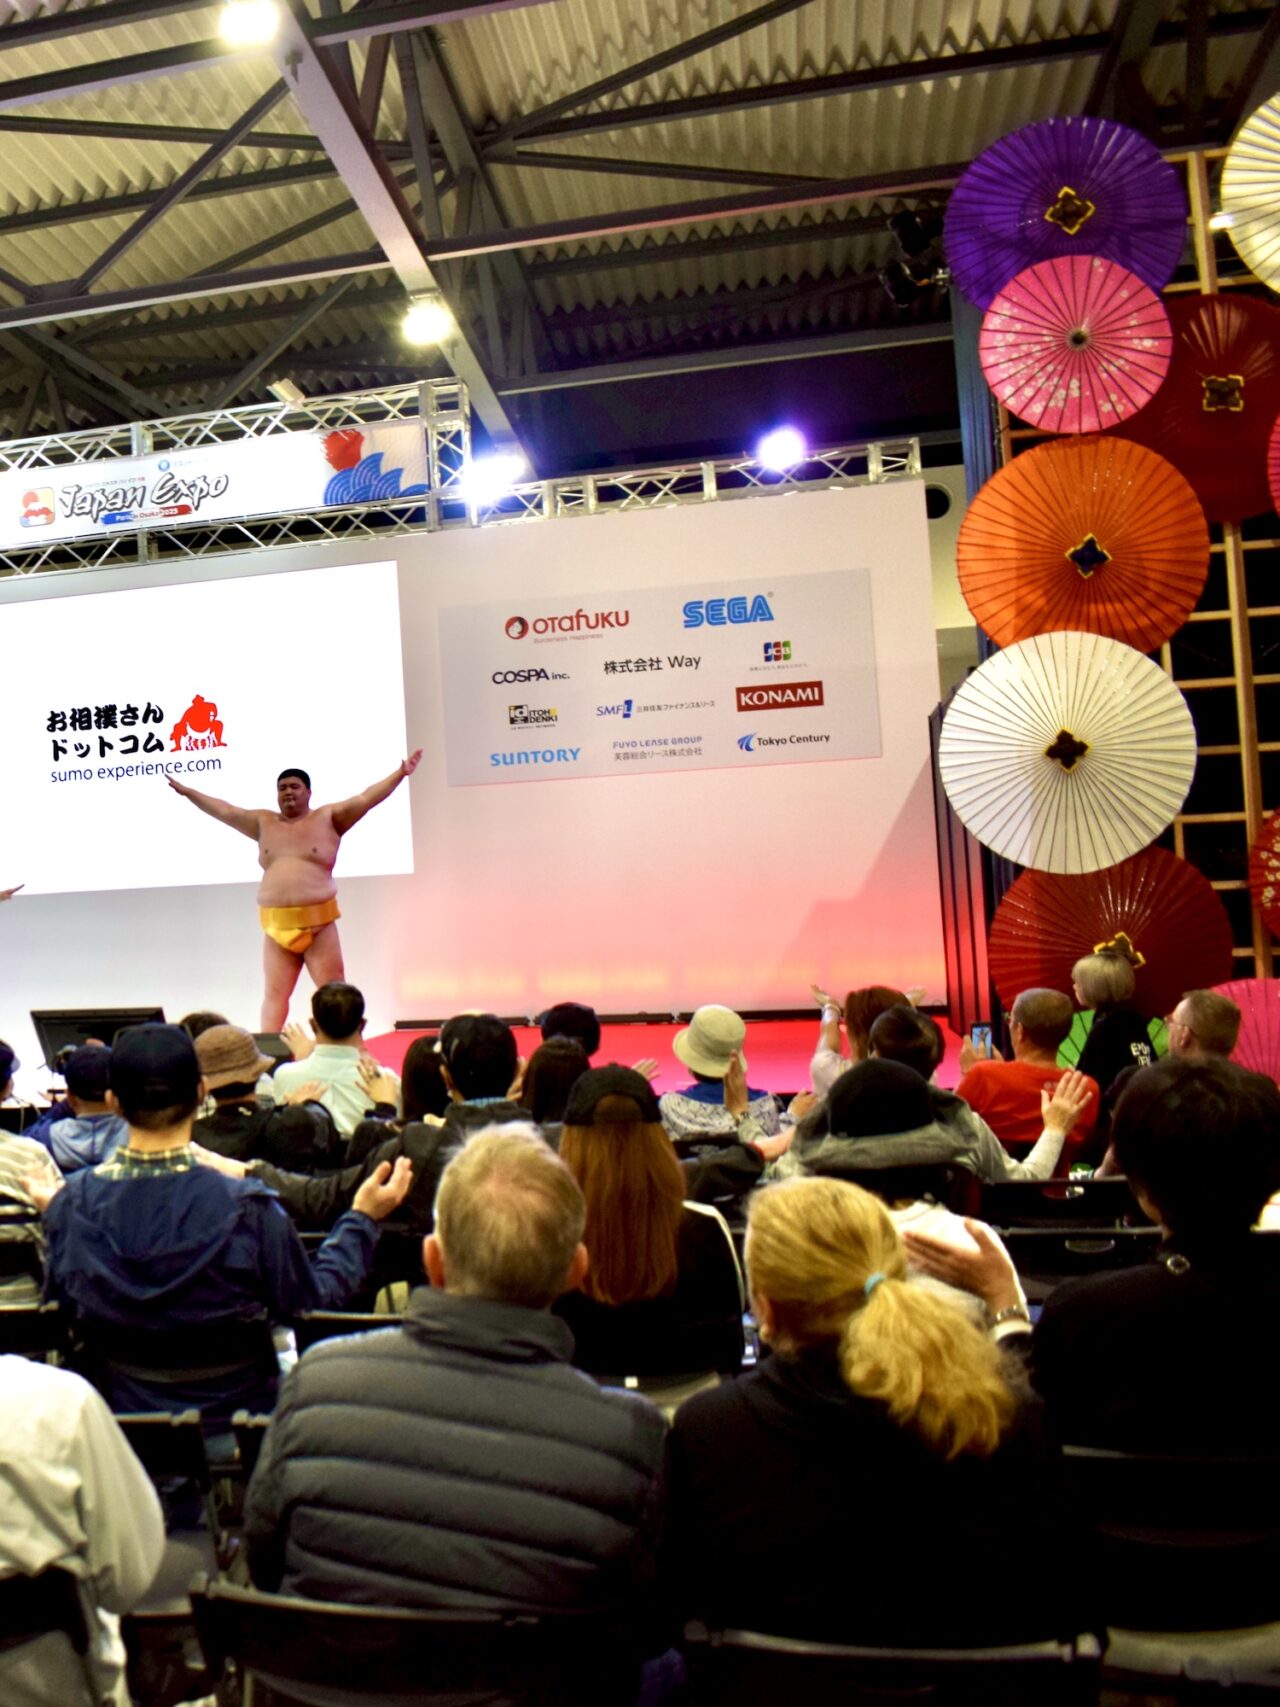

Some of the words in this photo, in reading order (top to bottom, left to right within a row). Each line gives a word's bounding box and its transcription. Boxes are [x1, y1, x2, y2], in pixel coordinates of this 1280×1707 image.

[60, 485, 146, 524] Japan
[151, 472, 229, 511] Expo
[683, 594, 774, 628] SEGA
[763, 640, 792, 662] JCB
[603, 657, 663, 675] 株式会社
[668, 655, 701, 669] Way
[491, 668, 550, 685] COSPA
[551, 672, 571, 680] inc.
[740, 687, 819, 706] KONAMI
[46, 702, 164, 733] お相撲さん
[529, 709, 550, 717] ITOH
[529, 715, 558, 724] DENKI
[52, 732, 164, 762] ドットコム
[613, 741, 638, 749] FUYO
[671, 736, 703, 745] GROUP
[757, 737, 788, 747] Tokyo
[789, 734, 831, 745] Century
[51, 768, 93, 783] sumo
[97, 758, 222, 780] experience.com
